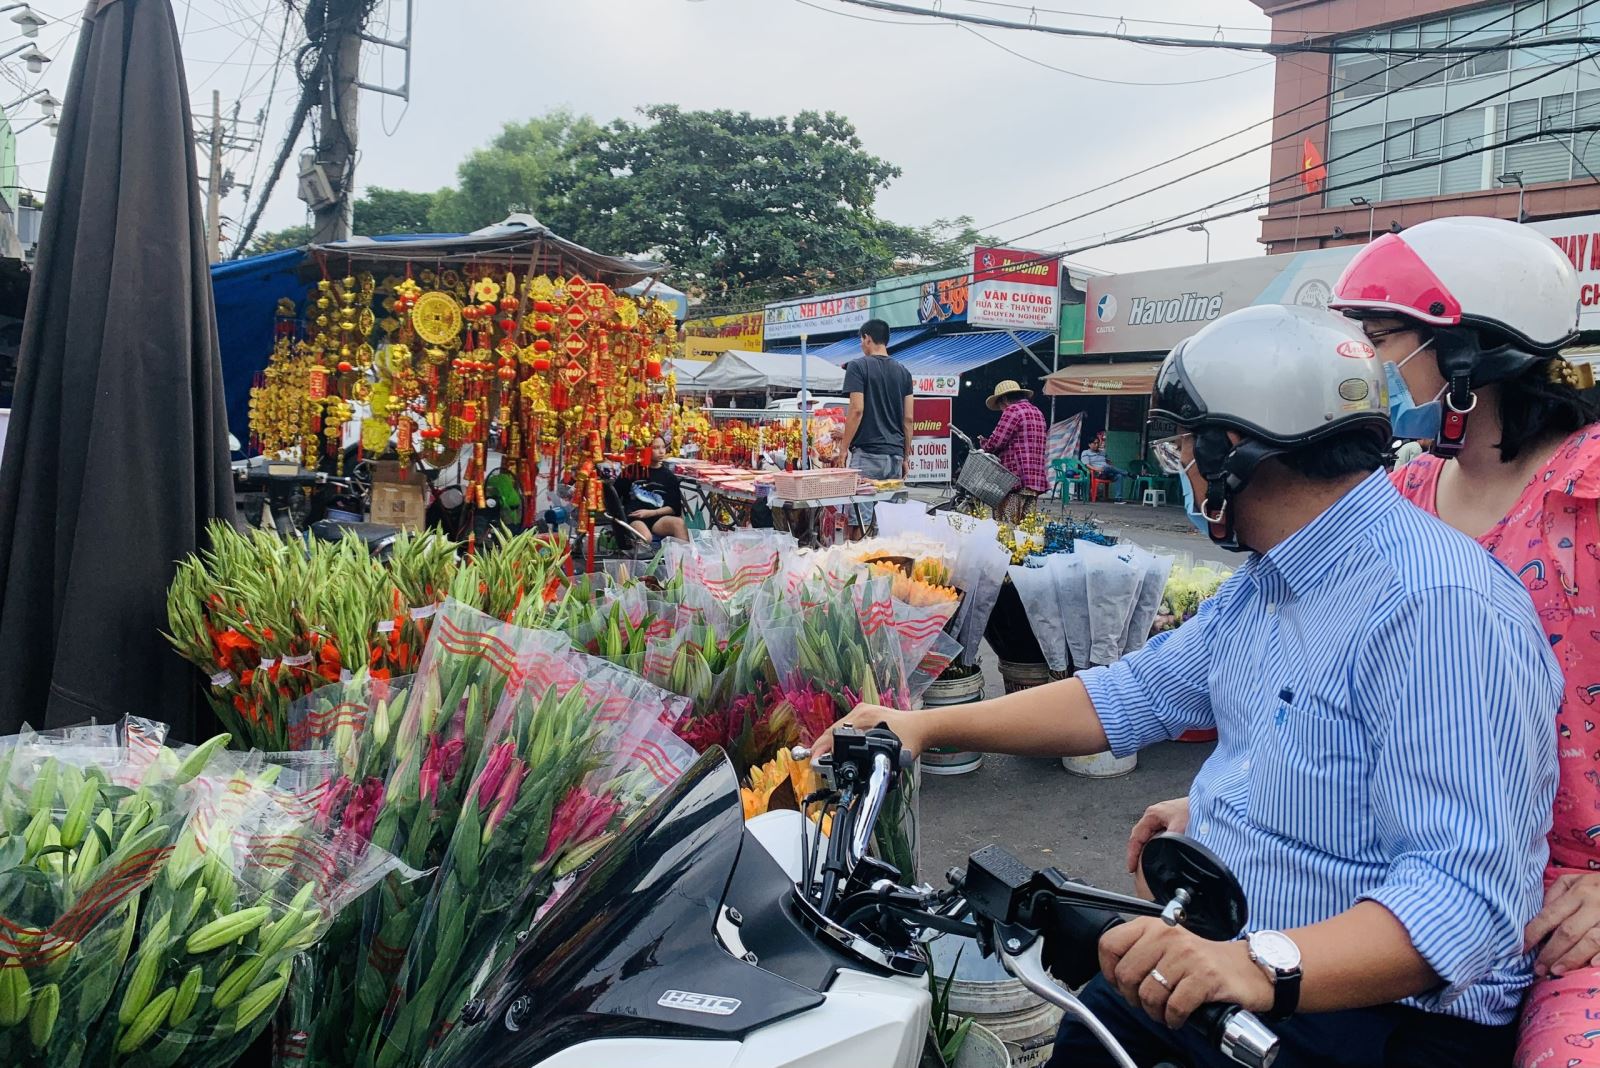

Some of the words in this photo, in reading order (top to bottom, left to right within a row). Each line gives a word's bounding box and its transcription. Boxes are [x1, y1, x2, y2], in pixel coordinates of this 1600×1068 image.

[800, 303, 817, 319] NHI
[994, 302, 1005, 310] XE
[1010, 303, 1031, 313] THAY
[1128, 292, 1224, 326] Havoline
[919, 378, 934, 392] 40K
[912, 419, 942, 431] voline
[917, 441, 947, 456] CƯỜNG
[920, 459, 934, 472] Thay
[665, 991, 737, 1010] HSTC
